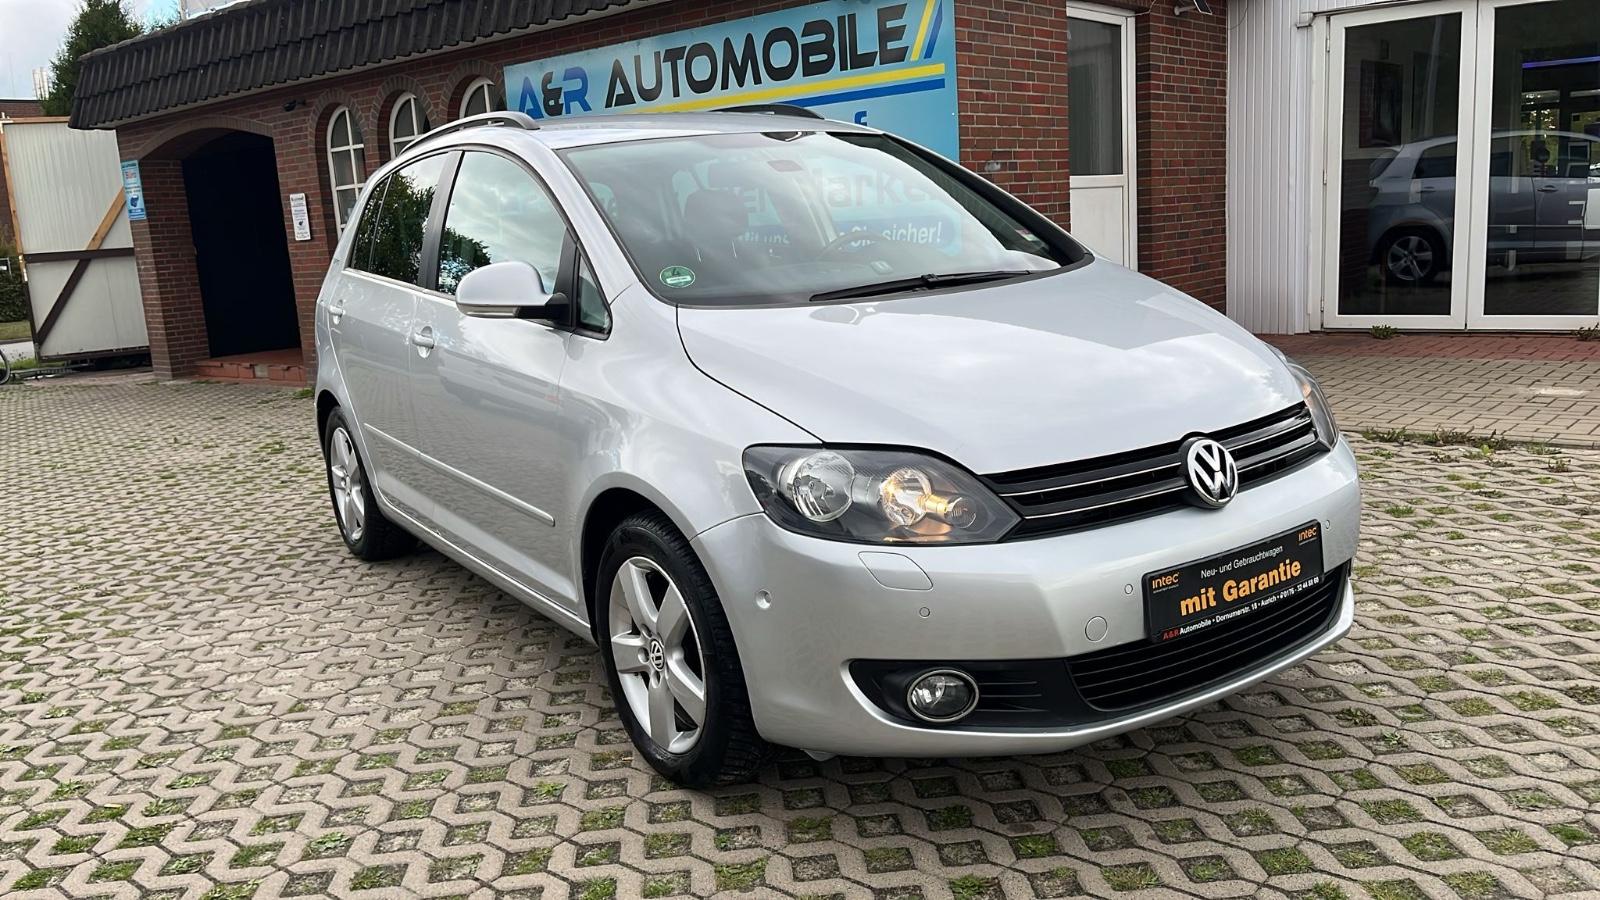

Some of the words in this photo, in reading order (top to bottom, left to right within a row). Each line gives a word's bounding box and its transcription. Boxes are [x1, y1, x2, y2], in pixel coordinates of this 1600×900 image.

[518, 66, 592, 119] A&R
[604, 3, 910, 108] AUTOMOBILE
[1201, 568, 1218, 579] Neu-
[1219, 561, 1232, 573] und
[1233, 545, 1283, 569] Gebrauchtwagen
[1180, 587, 1217, 616] mit
[1222, 559, 1301, 602] Garantie
[1180, 620, 1212, 635] Automobile
